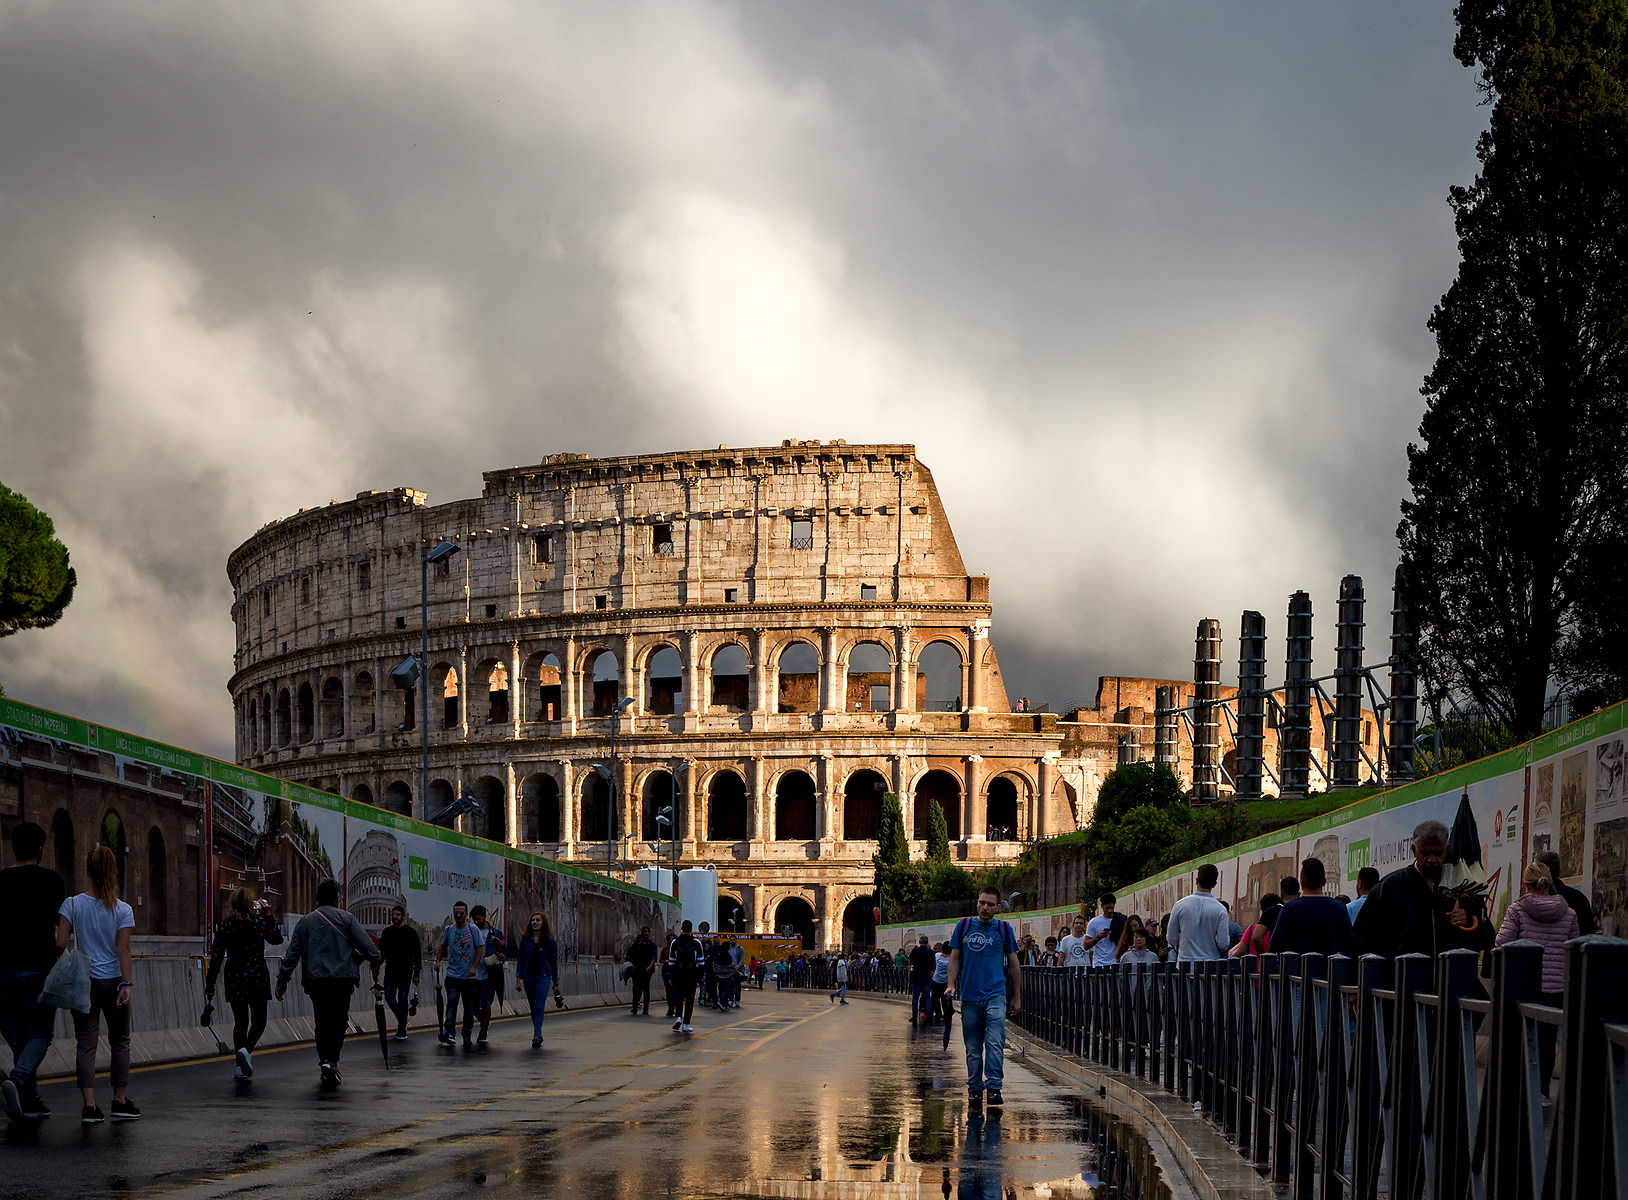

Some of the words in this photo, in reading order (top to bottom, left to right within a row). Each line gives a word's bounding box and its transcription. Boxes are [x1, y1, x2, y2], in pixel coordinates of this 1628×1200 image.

[31, 713, 43, 728] FORI
[43, 716, 69, 735] IMPERIALI
[115, 736, 128, 751] LINEA
[144, 745, 176, 763] METROPOLITANA
[1349, 847, 1364, 874] LINEA
[409, 862, 423, 883] LINEA
[976, 936, 994, 946] Rock
